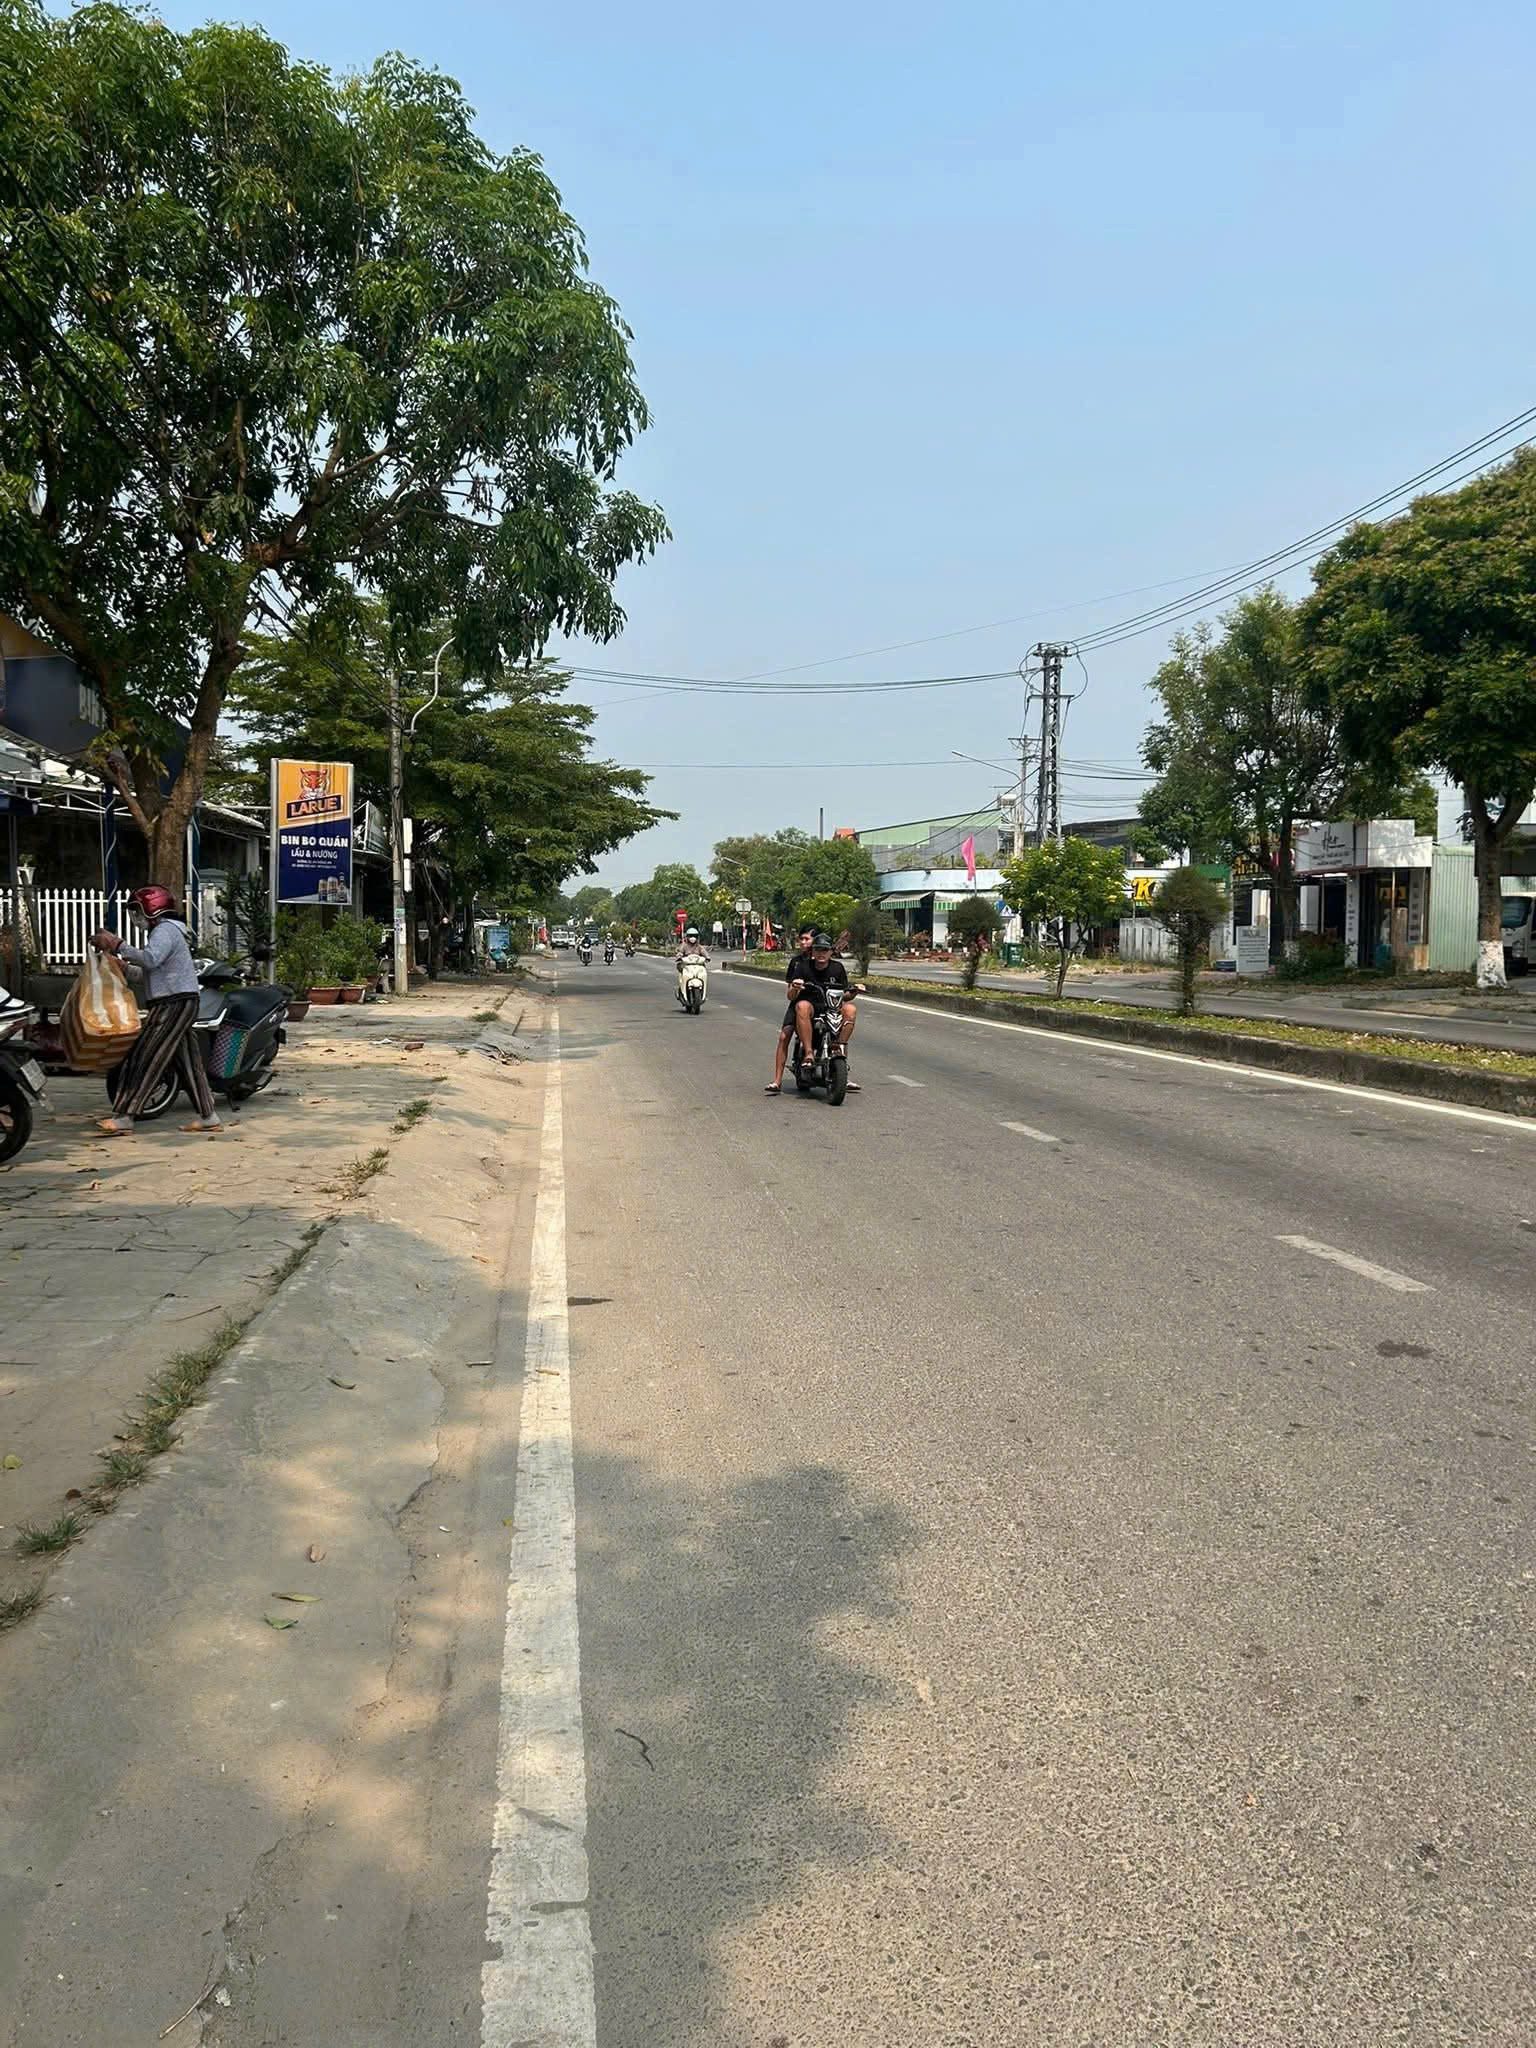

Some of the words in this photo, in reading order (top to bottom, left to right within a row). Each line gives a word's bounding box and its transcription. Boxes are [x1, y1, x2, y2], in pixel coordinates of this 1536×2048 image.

[291, 797, 337, 816] LARUE
[281, 835, 299, 845] BIN
[302, 836, 316, 846] BO
[319, 835, 348, 847] QUÁN
